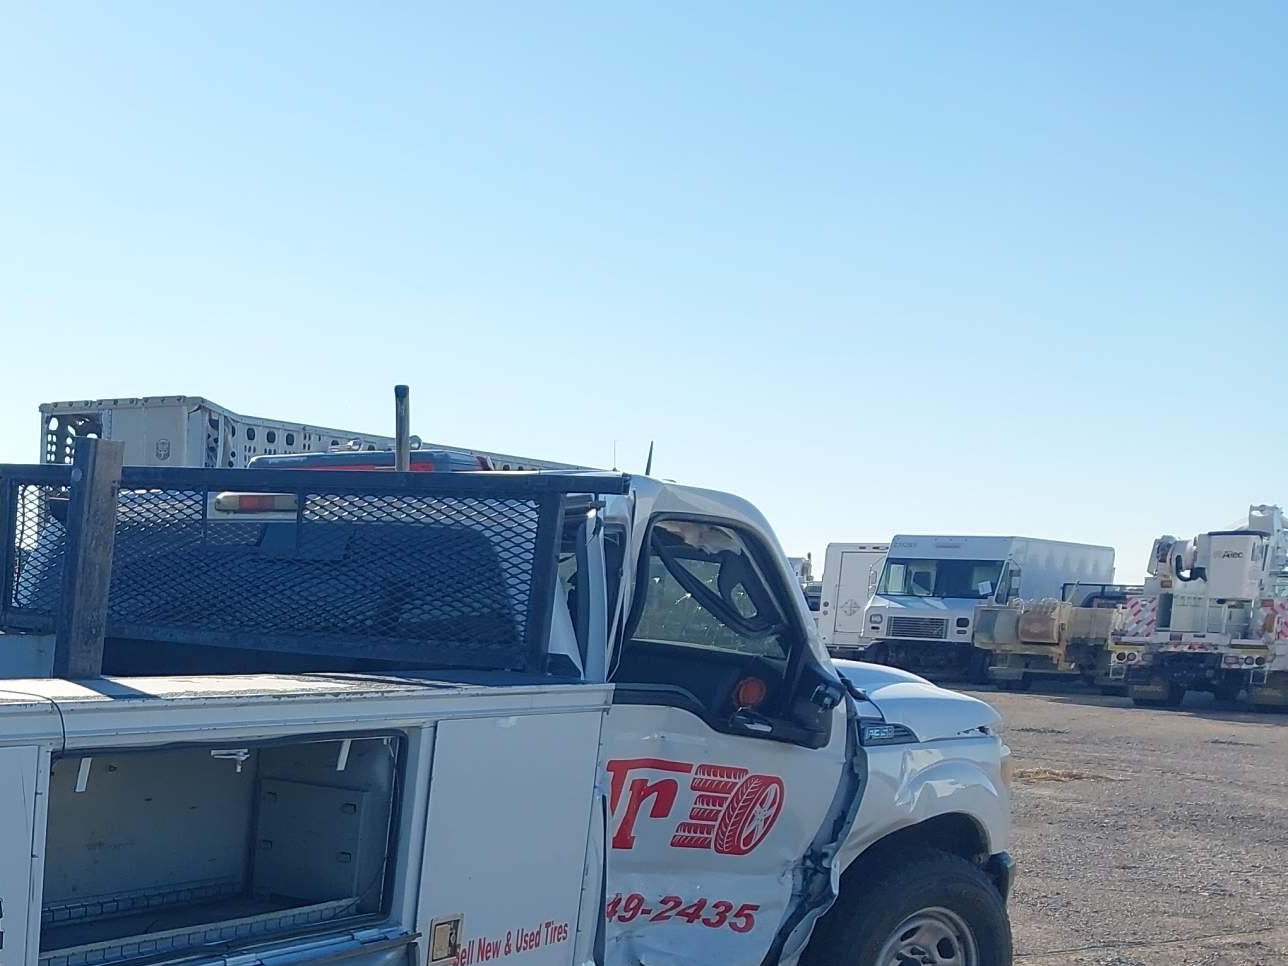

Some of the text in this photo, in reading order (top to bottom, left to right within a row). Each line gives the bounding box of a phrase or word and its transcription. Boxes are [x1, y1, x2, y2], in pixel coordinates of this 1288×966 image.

[476, 937, 502, 963] New
[503, 931, 513, 957] &
[515, 922, 542, 953] Used
[544, 920, 569, 946] Tires
